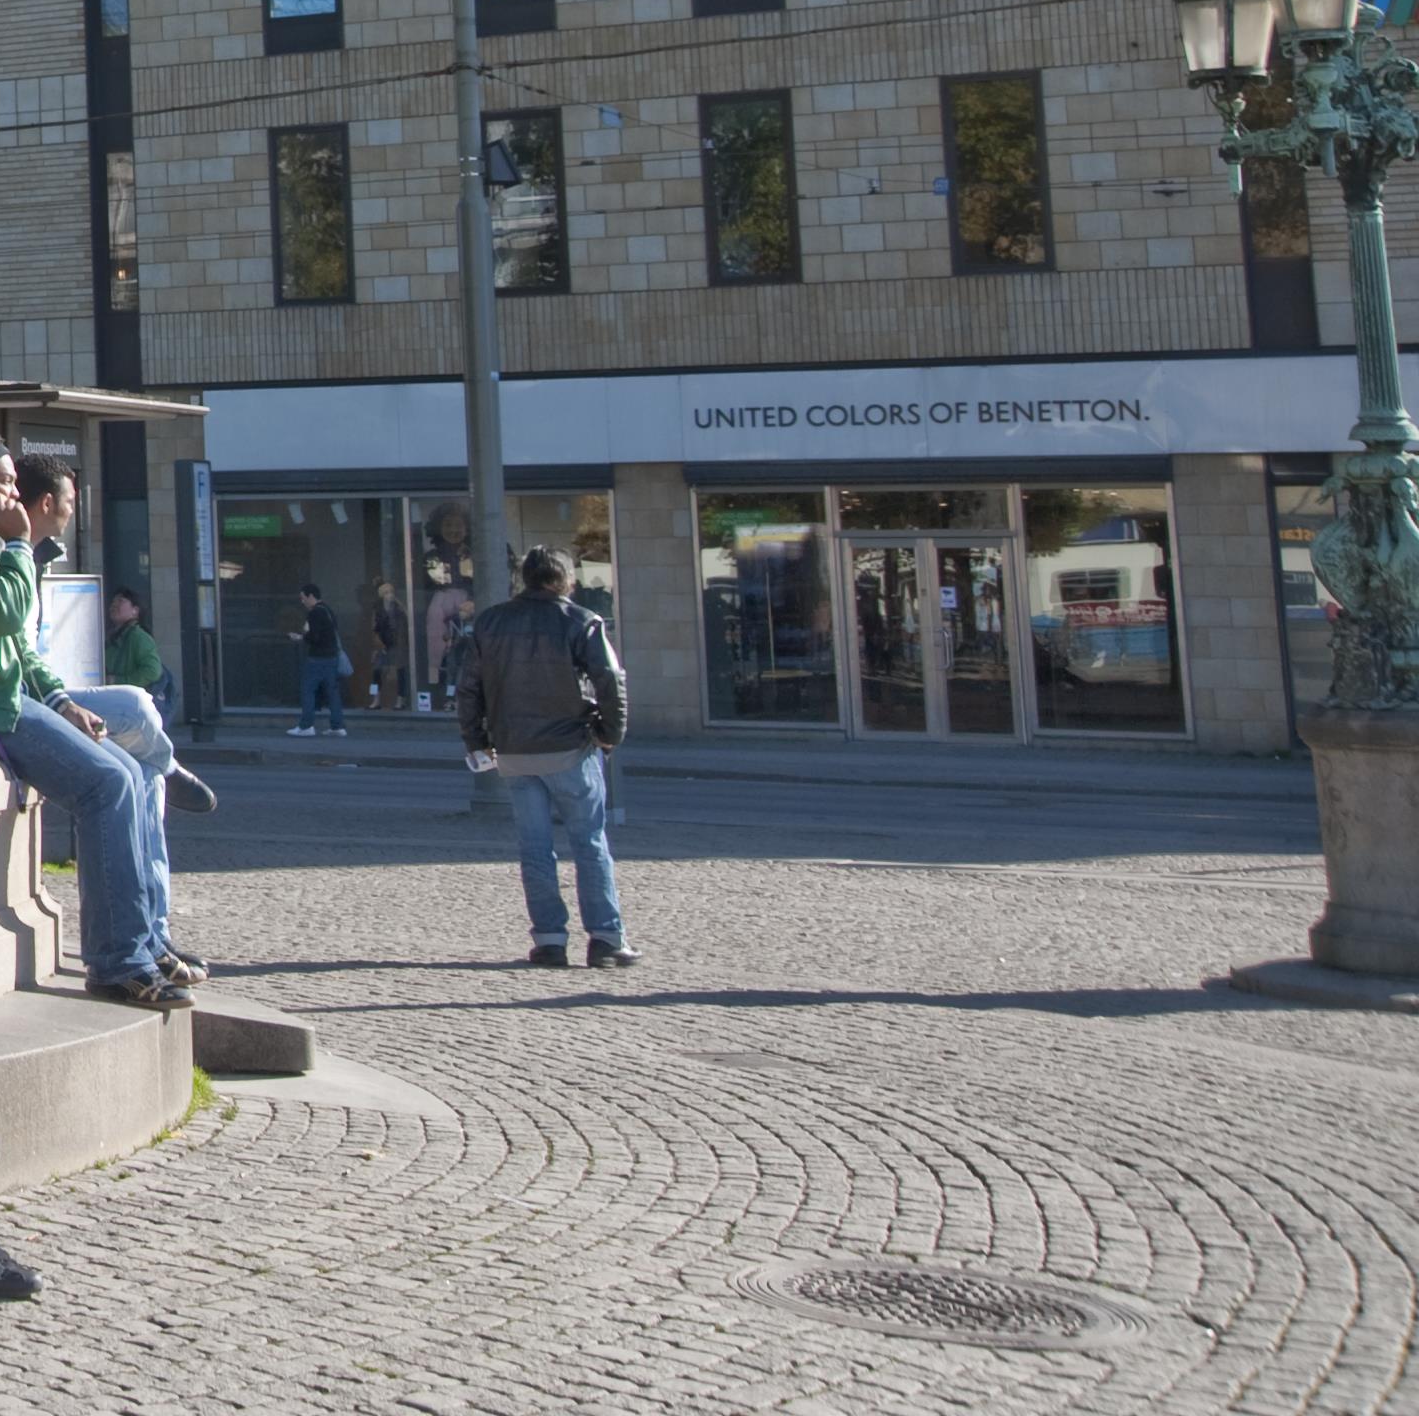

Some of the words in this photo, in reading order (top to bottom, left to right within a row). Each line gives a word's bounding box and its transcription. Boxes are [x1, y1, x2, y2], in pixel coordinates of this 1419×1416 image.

[694, 406, 798, 429] UNITED
[806, 403, 921, 427] COLORS
[929, 401, 968, 424] OF
[978, 399, 1150, 423] BENETTON.
